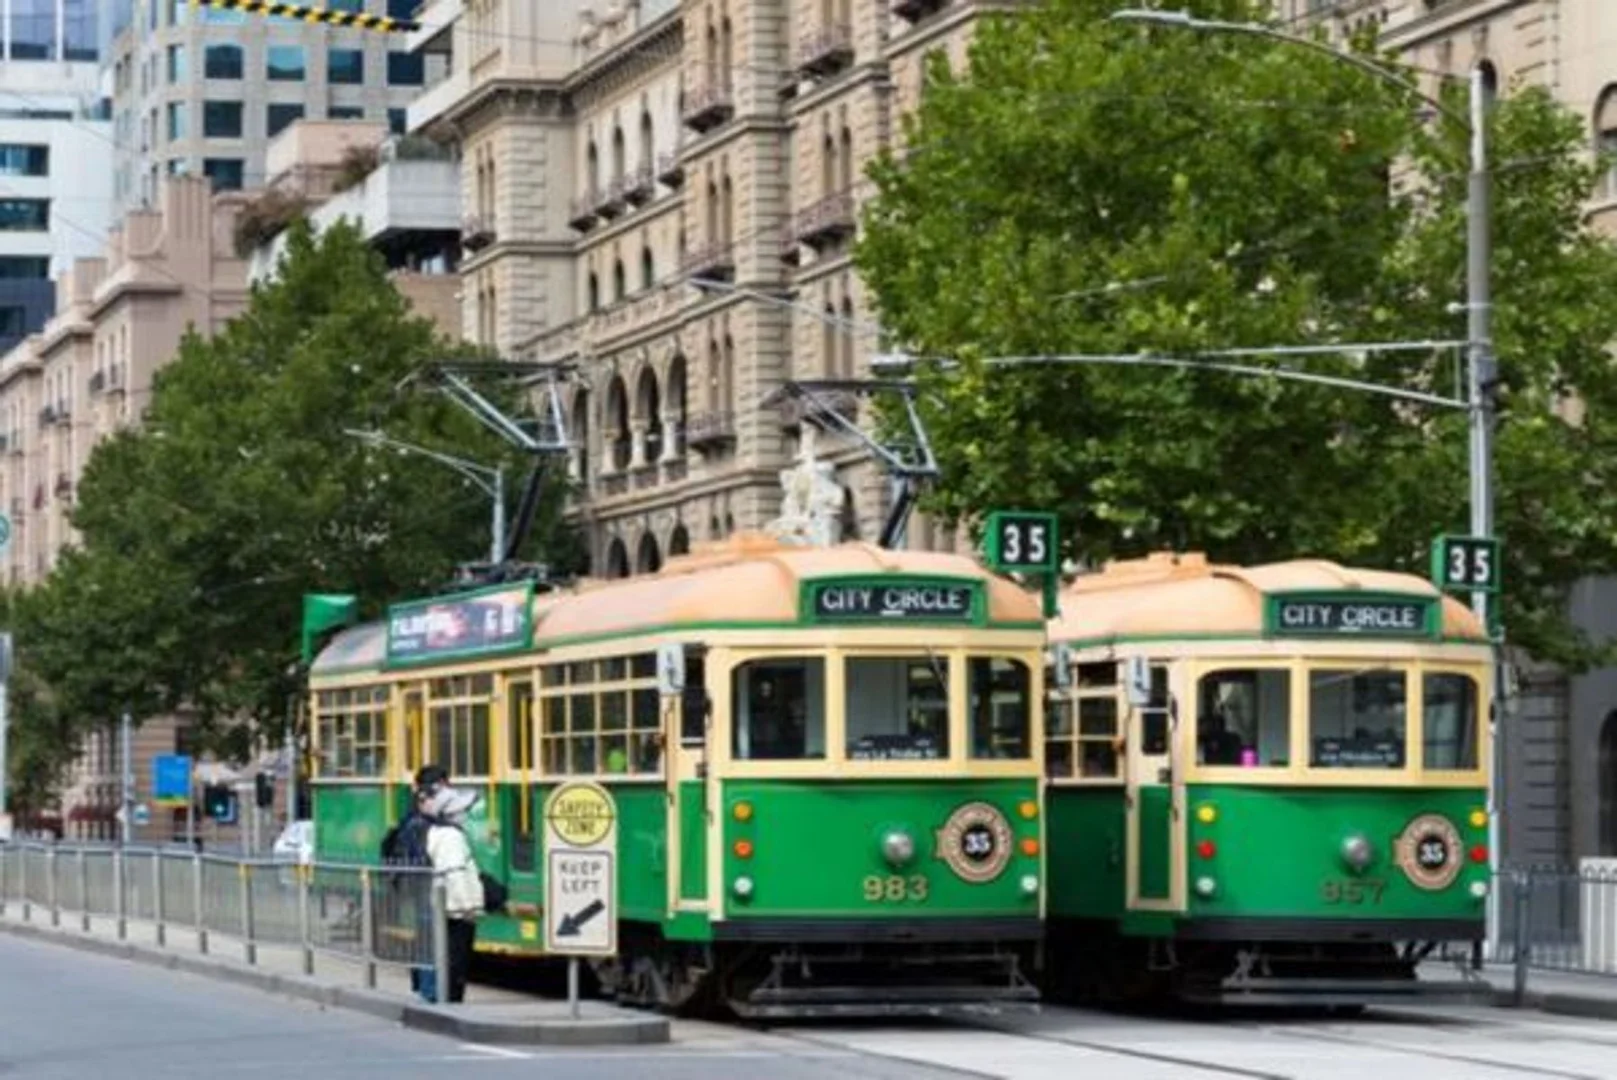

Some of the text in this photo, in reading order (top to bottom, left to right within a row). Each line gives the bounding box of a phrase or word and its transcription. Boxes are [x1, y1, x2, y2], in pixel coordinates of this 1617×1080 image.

[1003, 525, 1045, 562] 35
[1450, 546, 1489, 582] 35
[822, 588, 962, 609] CITY CIRCLE
[1283, 605, 1416, 627] CITY CIRCLE
[559, 800, 603, 816] SAFETY
[565, 819, 595, 835] ZONE
[965, 830, 992, 854] 35
[1420, 841, 1445, 864] 35
[560, 861, 602, 876] KEEP
[562, 879, 600, 894] LEFT
[863, 874, 928, 901] 983
